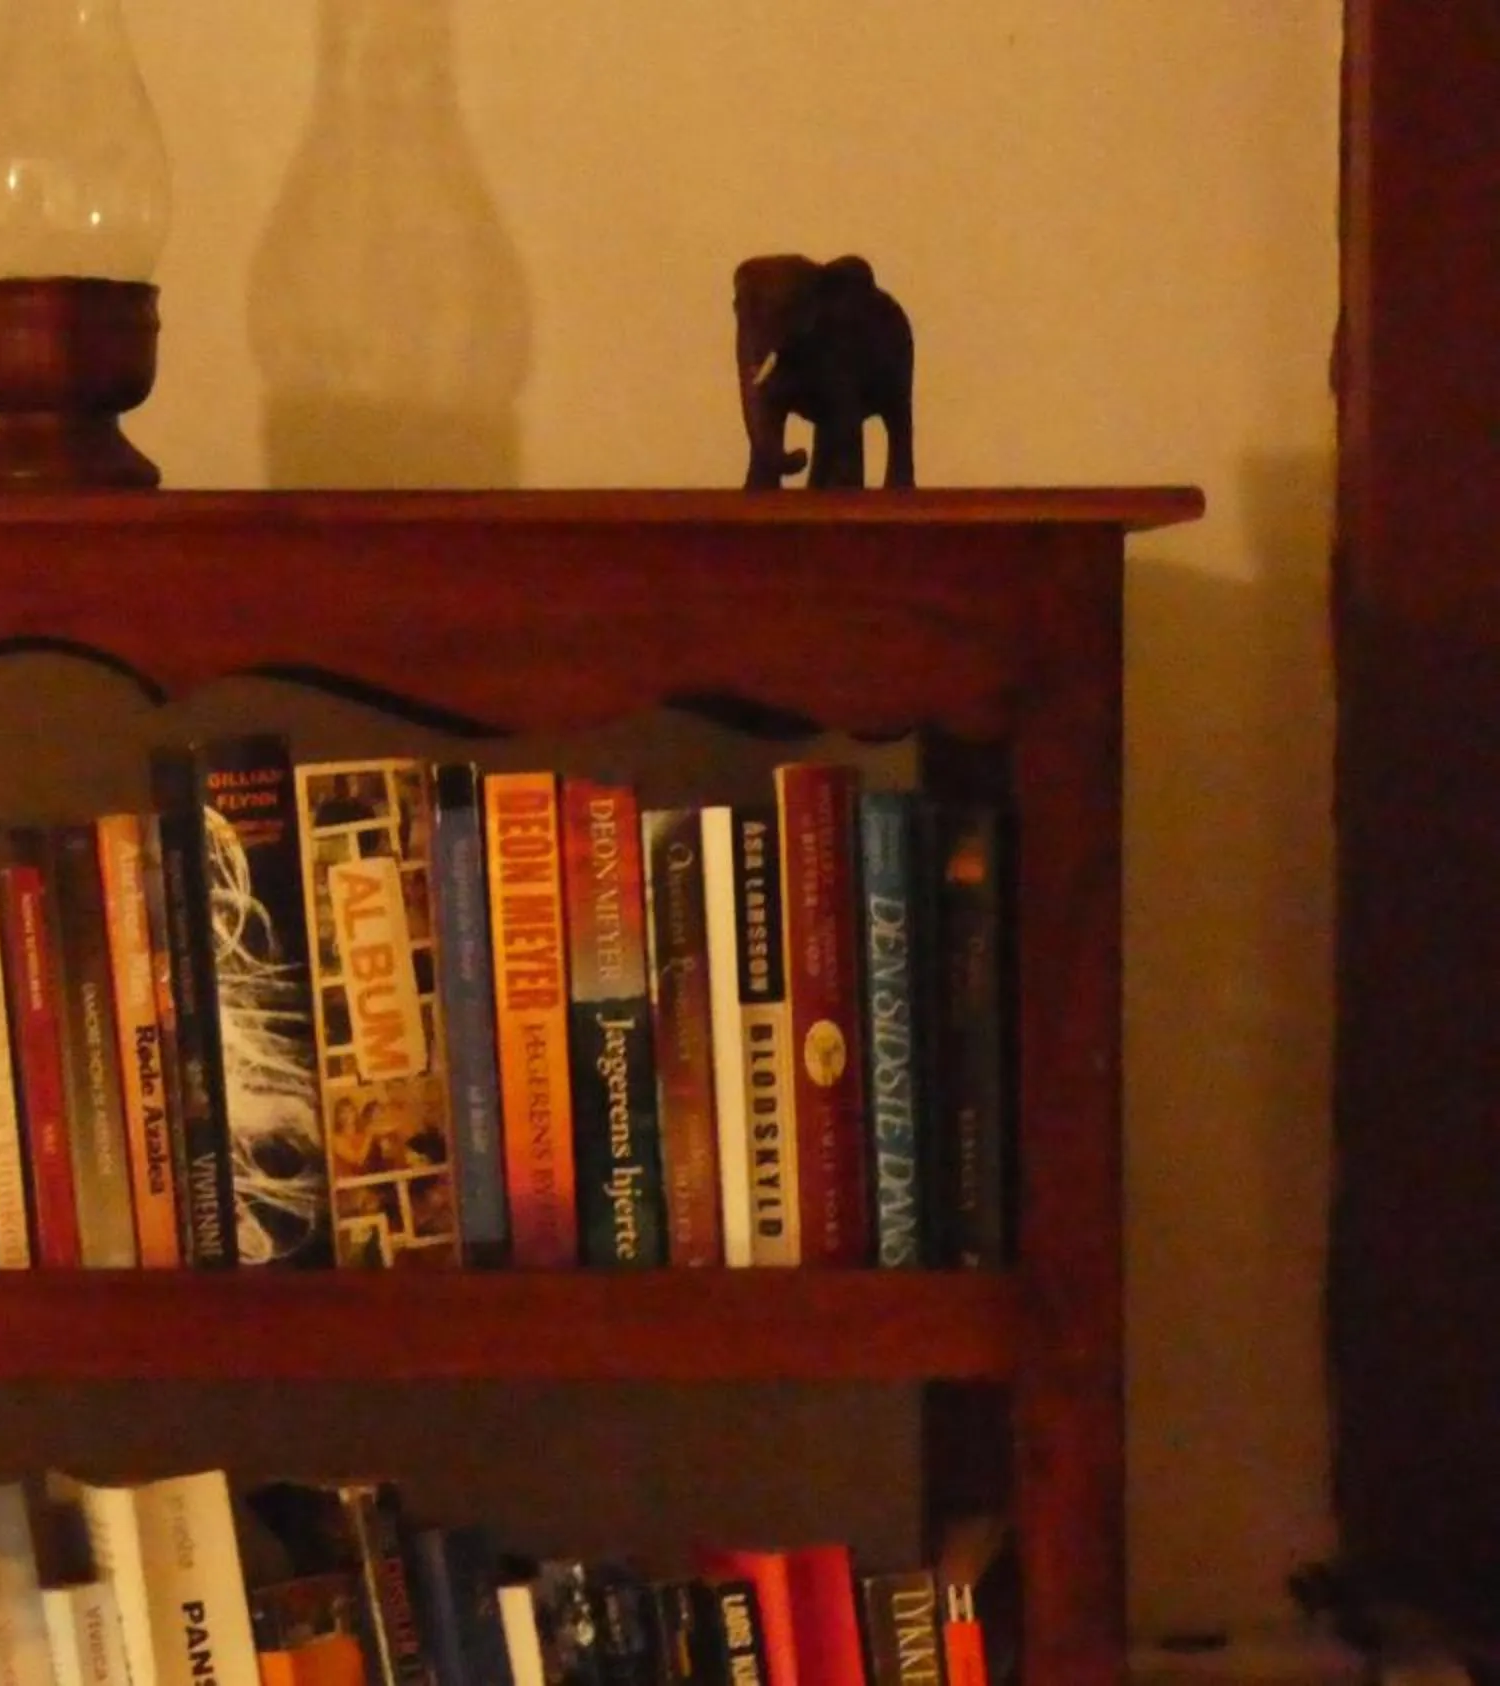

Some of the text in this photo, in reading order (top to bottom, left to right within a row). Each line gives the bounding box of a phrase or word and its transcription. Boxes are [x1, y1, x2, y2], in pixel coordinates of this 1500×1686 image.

[338, 869, 412, 1070] ALBUM
[495, 791, 562, 1014] DEON MEYER
[588, 800, 622, 984] DEON MEYER
[742, 821, 769, 994] ÅSA LARSSON
[869, 894, 907, 982] DEN
[134, 1024, 169, 1196] Røde Azalea
[595, 1012, 642, 1262] Jægerens hjerte
[750, 1023, 785, 1240] BLODSKYLD
[871, 989, 912, 1142] SIDSTE
[878, 1151, 916, 1269] DANS
[84, 1606, 109, 1682] Viveca
